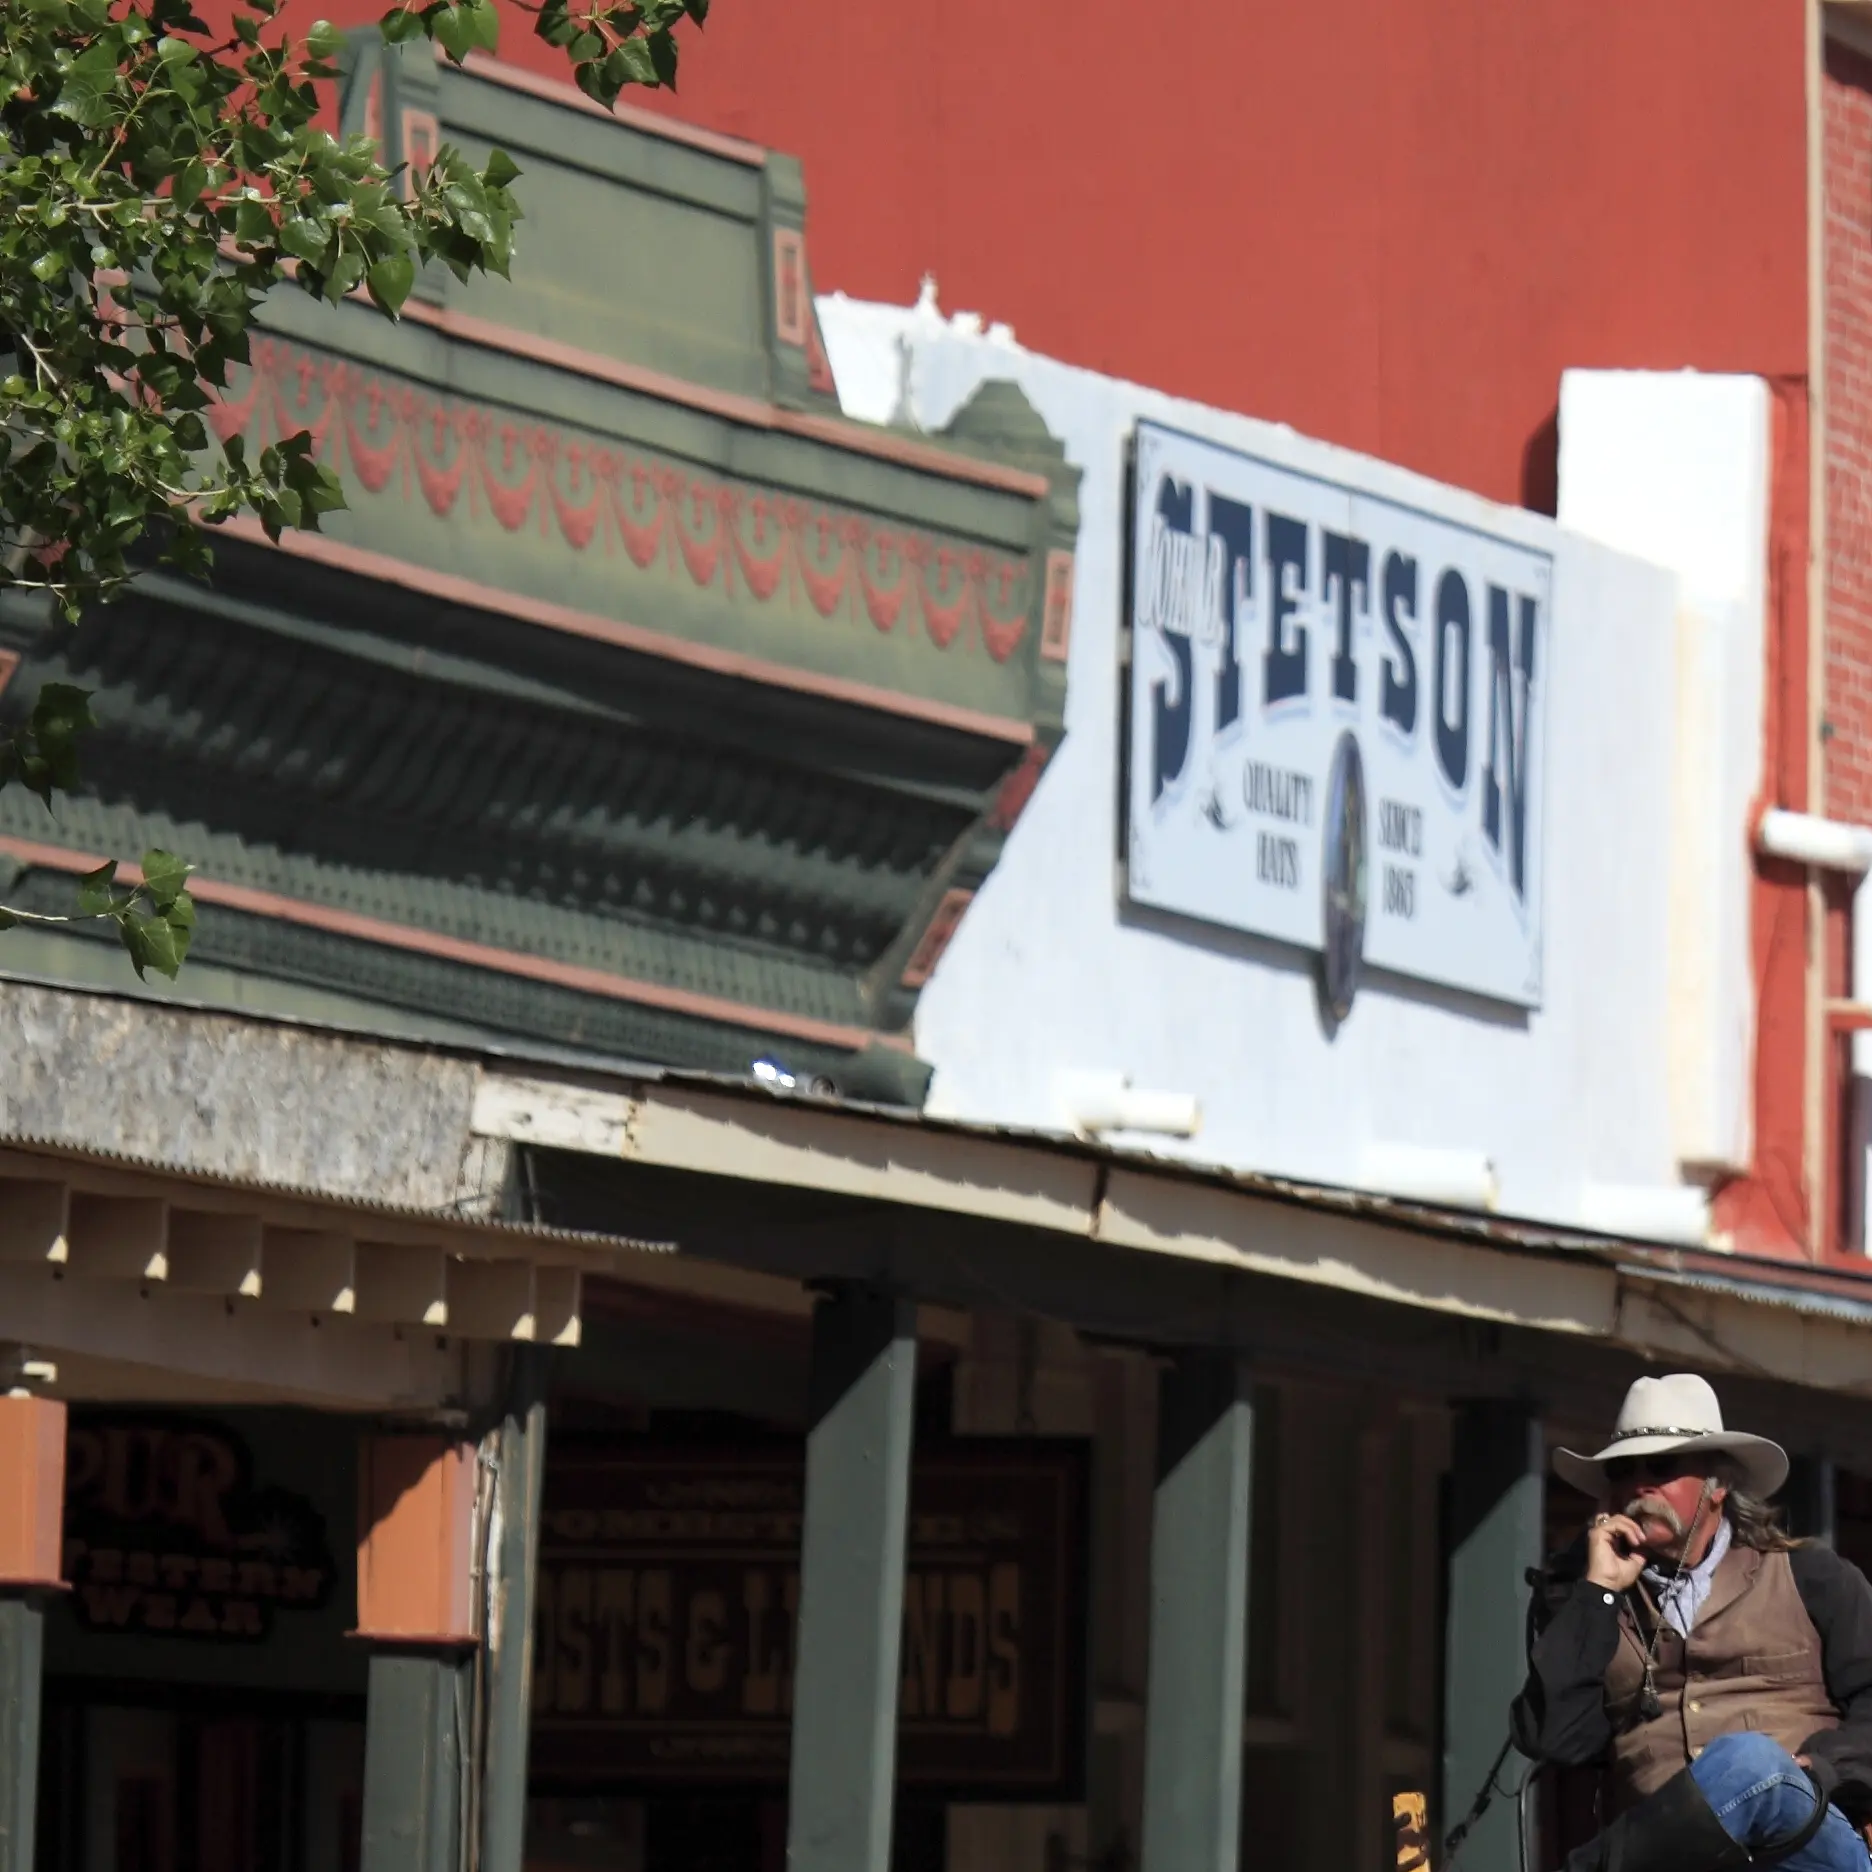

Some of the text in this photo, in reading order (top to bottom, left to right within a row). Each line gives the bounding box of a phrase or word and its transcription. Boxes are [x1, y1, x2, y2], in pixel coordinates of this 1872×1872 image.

[1138, 513, 1206, 638] JOHN
[1150, 469, 1540, 906] STETSON
[1243, 760, 1313, 826] QUALITY
[1256, 832, 1299, 889] HATS
[81, 1584, 264, 1637] WEAR
[685, 1589, 735, 1693] &
